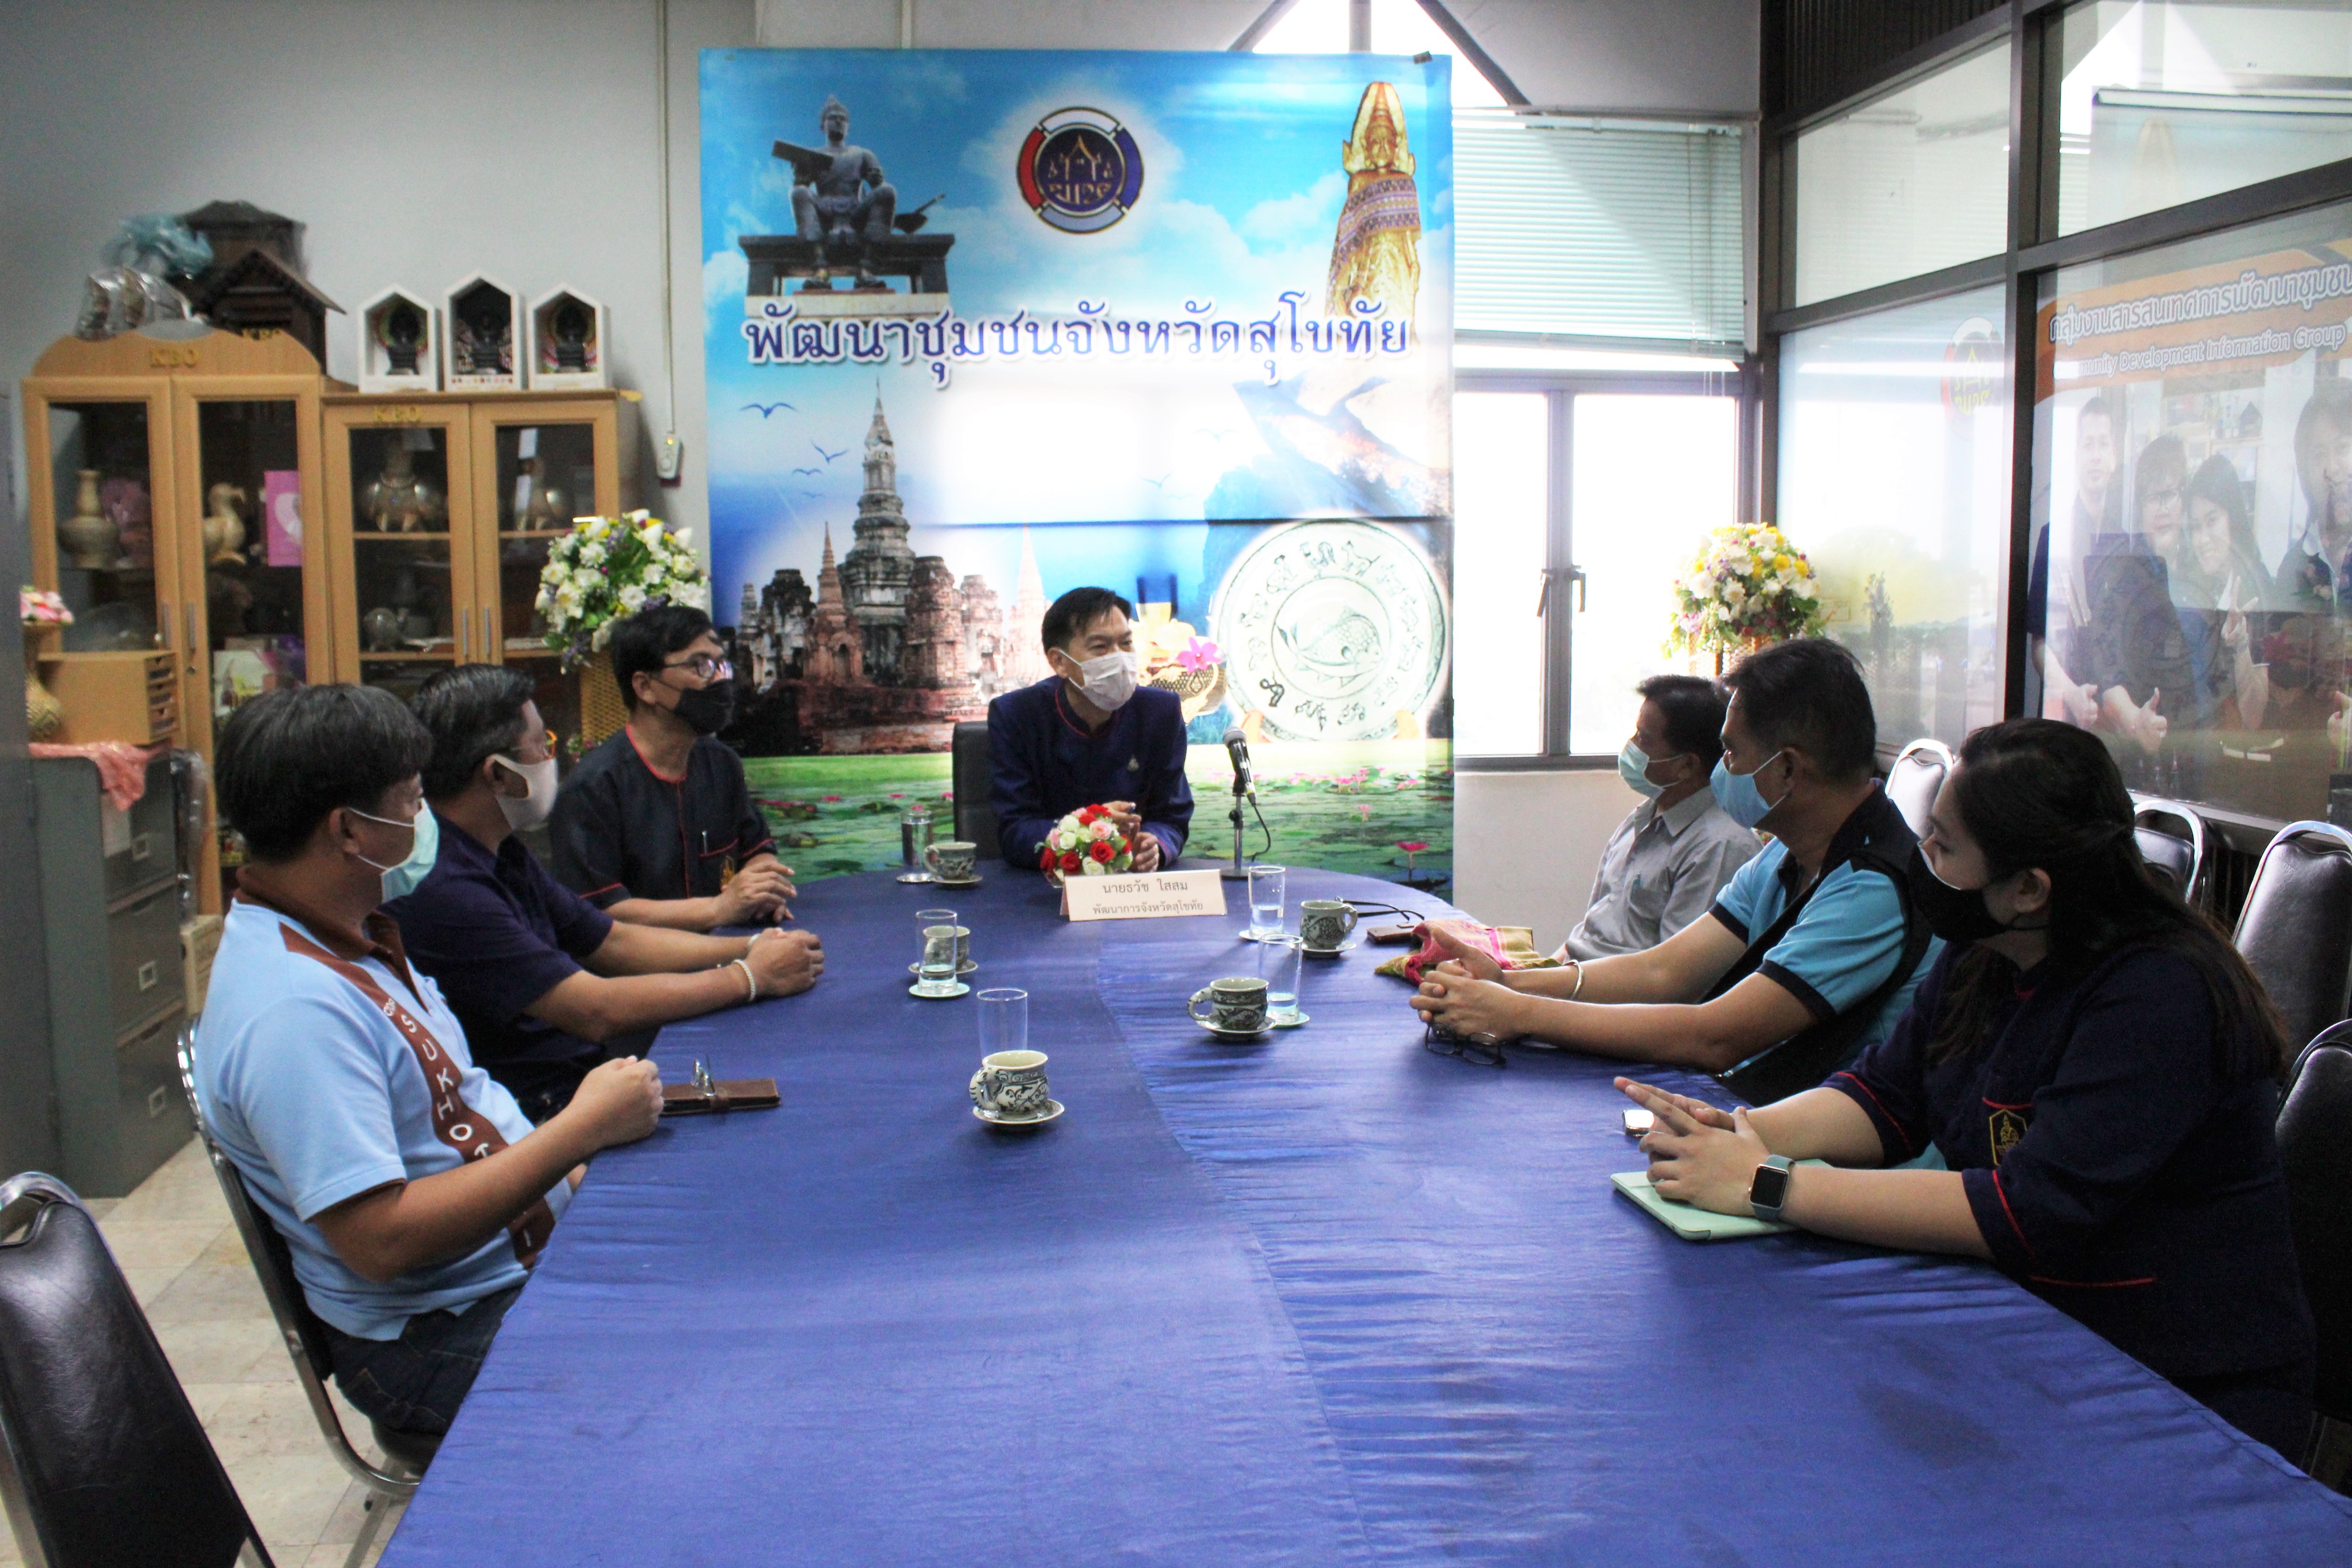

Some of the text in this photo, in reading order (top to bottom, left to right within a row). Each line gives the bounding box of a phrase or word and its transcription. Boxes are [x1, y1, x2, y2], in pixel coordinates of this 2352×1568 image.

[745, 290, 1407, 383] พัฒนาชุมชนจังหวัดสุโขทัย
[2119, 342, 2205, 371] Development
[2206, 329, 2291, 360] Information
[2293, 324, 2346, 350] Group
[1102, 878, 1188, 893] นายธวัช ใสสม
[1092, 900, 1203, 914] พัฒนาการจังหวัดสุโขทัย
